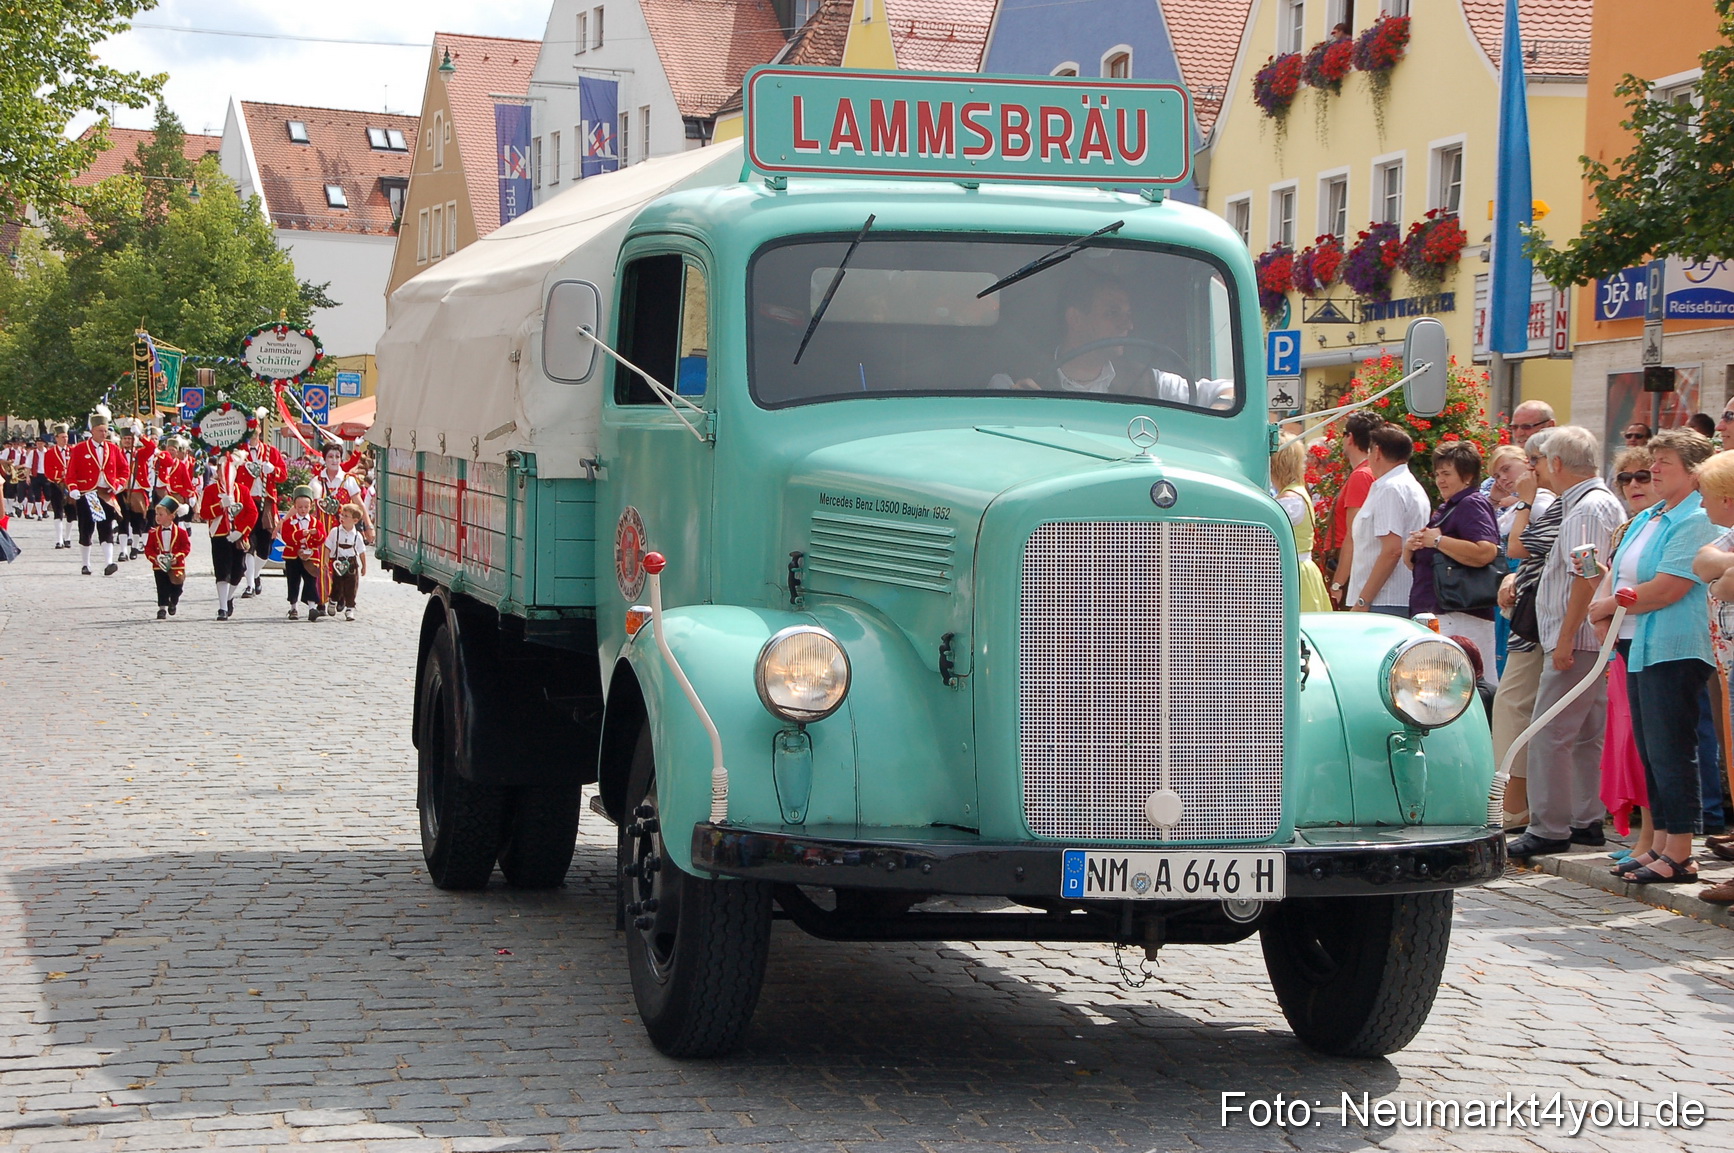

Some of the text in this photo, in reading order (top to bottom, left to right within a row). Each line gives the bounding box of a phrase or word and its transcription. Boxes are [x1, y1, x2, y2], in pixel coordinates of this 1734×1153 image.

[792, 95, 1149, 165] LAMMSBRÄU
[1602, 282, 1629, 304] DER
[1669, 300, 1734, 313] Reisebüro
[1555, 290, 1567, 350] INO
[260, 346, 302, 355] Lammsbräu
[1273, 335, 1294, 371] P
[256, 355, 301, 367] Schäffler
[260, 366, 296, 374] Tanzgruppe
[206, 420, 240, 429] Lammsbräu
[203, 428, 242, 439] Schäffler
[819, 492, 951, 520] Mercedes Benz L3500 Baujahr 1952
[1087, 858, 1274, 893] NM A 646 H
[1069, 879, 1078, 889] D
